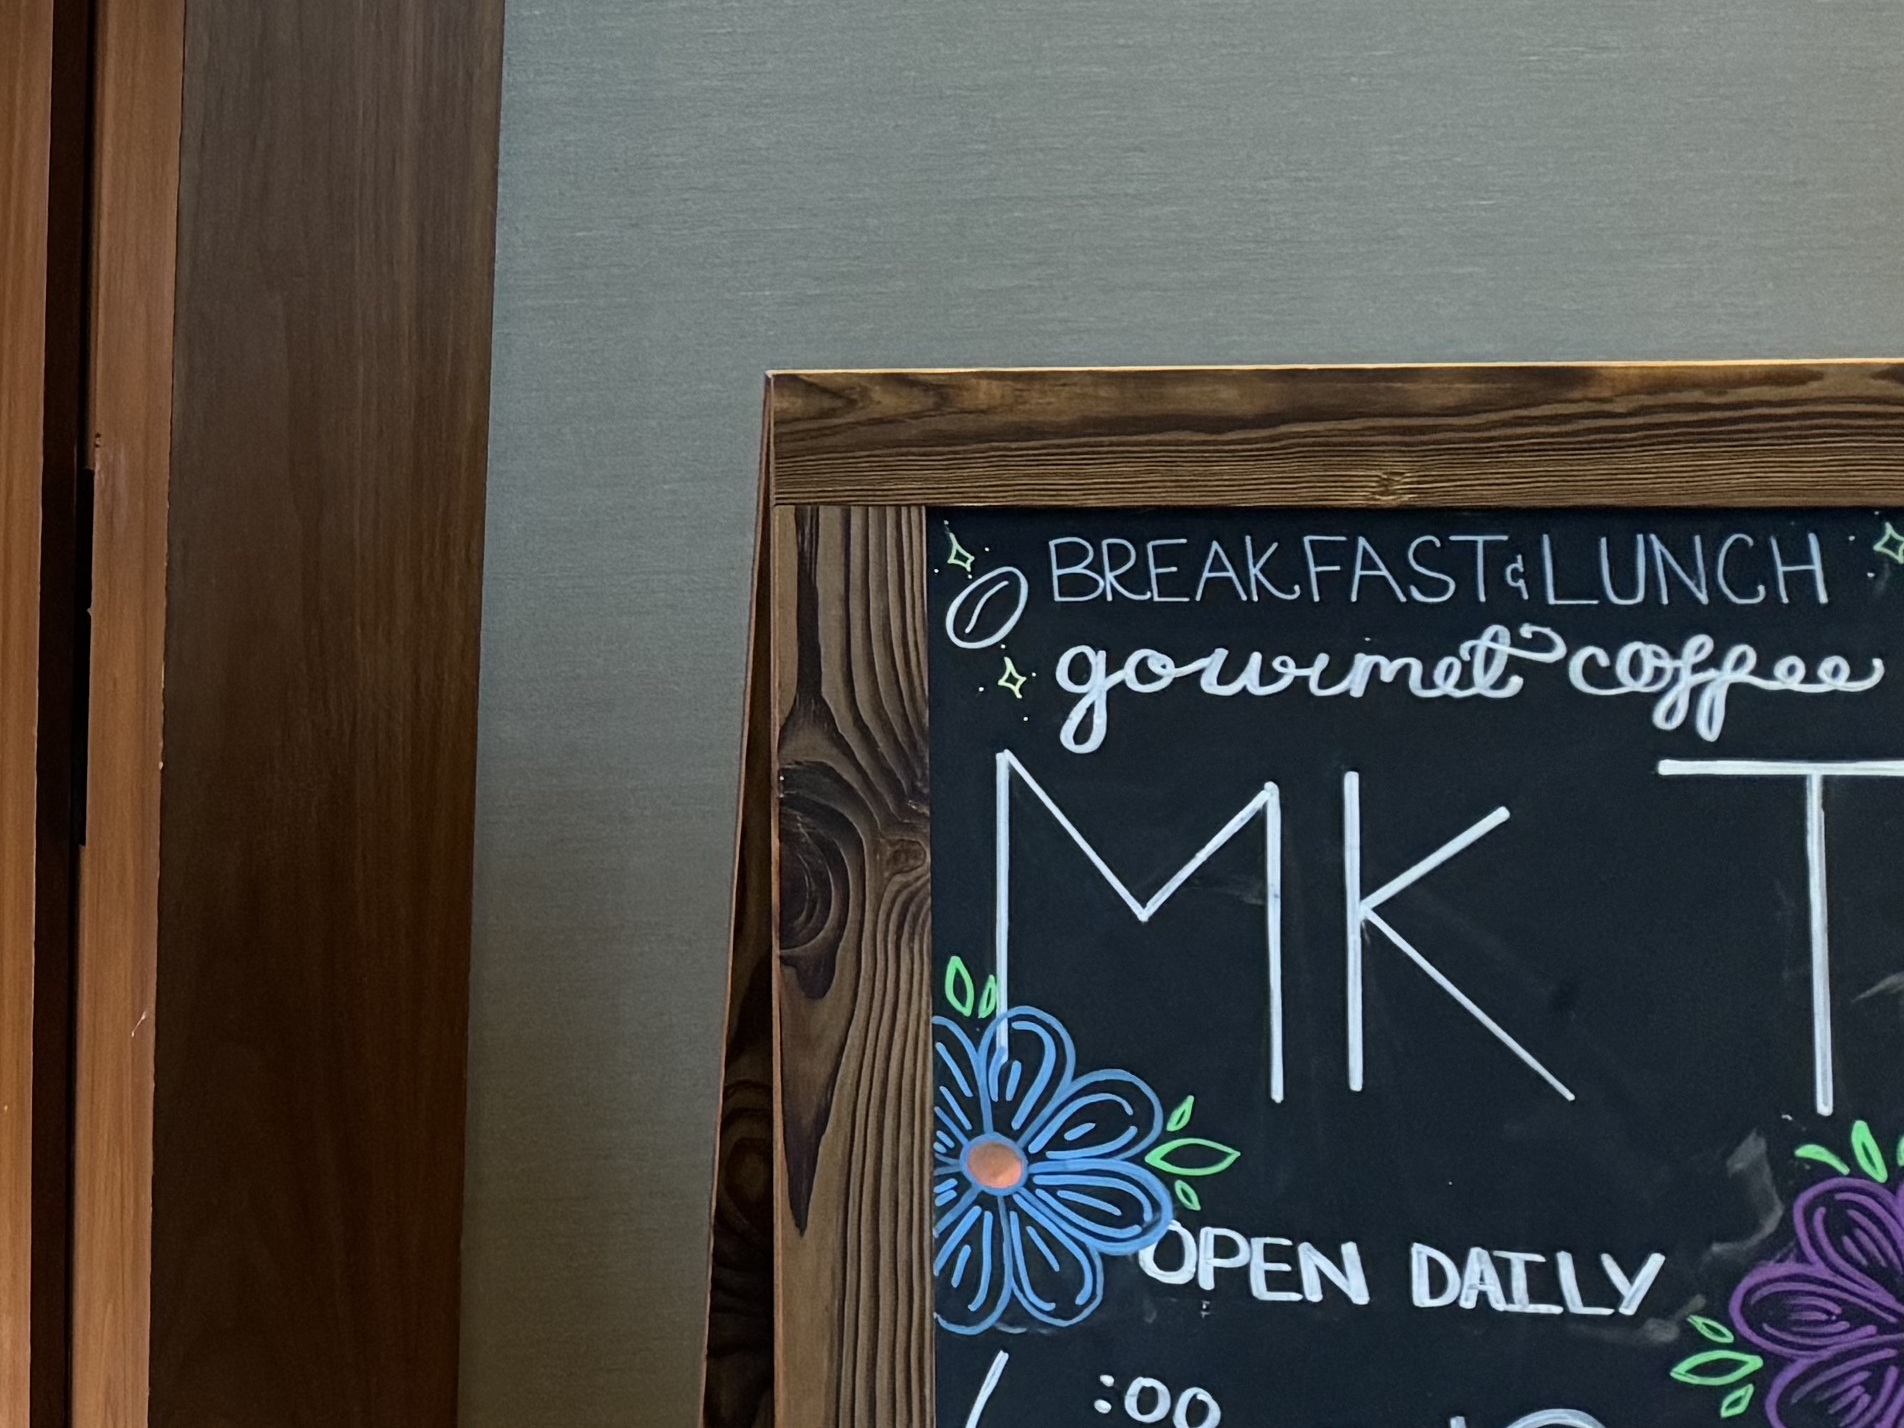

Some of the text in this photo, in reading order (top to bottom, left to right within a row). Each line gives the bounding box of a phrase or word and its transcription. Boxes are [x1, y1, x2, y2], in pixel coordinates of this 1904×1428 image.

[1049, 535, 1508, 603] BREAKFAST
[1543, 533, 1829, 605] LUNCH
[1055, 622, 1885, 754] gourmet coffee
[1138, 1219, 1667, 1316] OPEN DAILY
